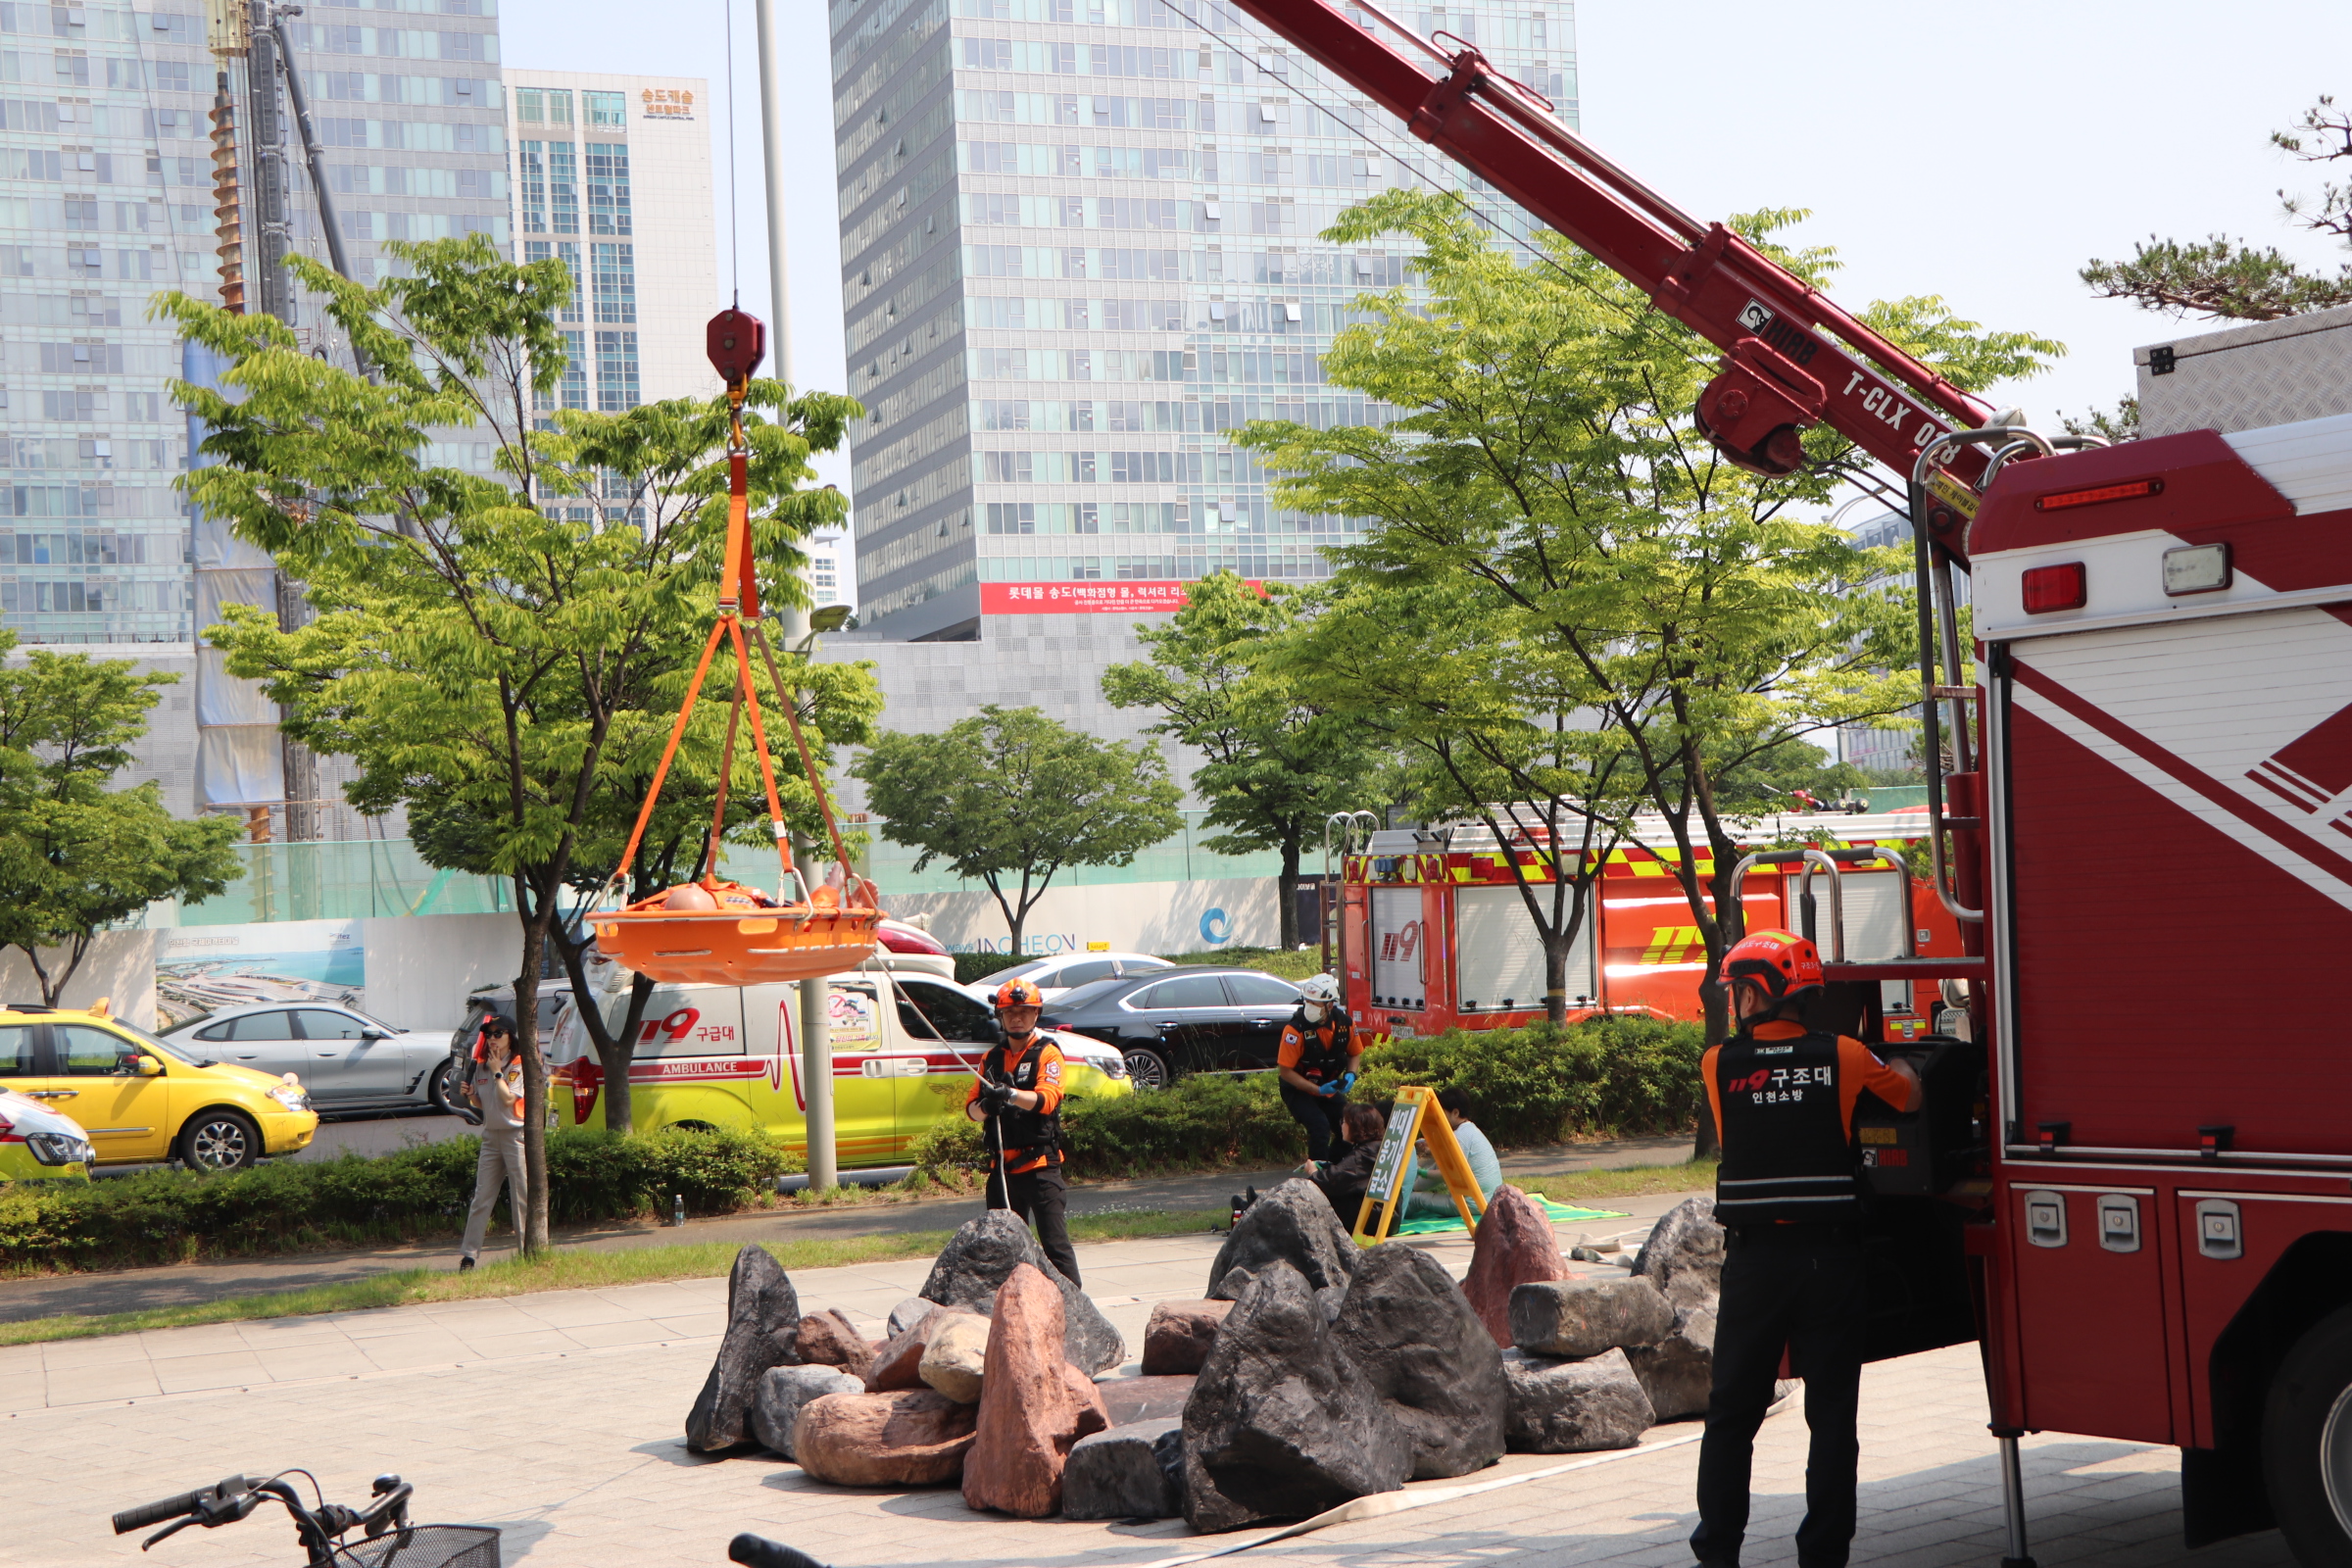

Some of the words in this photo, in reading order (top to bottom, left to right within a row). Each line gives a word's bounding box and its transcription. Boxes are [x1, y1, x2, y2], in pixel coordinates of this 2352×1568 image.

[642, 88, 694, 104] 송도캐슬
[646, 104, 691, 115] 센트럴파크
[1765, 318, 1818, 366] HIAB
[1842, 370, 1911, 431] T-CLX
[1914, 422, 1961, 465] 08
[1008, 586, 1045, 600] 롯데몰
[1049, 586, 1116, 600] 송도(백화점형
[1120, 587, 1135, 599] 몰,
[1138, 587, 1167, 598] 럭셔리
[946, 943, 974, 953] ways
[1380, 920, 1418, 961] 119
[697, 1026, 735, 1042] 구급대
[662, 1061, 737, 1075] AMBULANCE
[1752, 1089, 1803, 1103] 인천소방
[1879, 1150, 1908, 1166] HIAB
